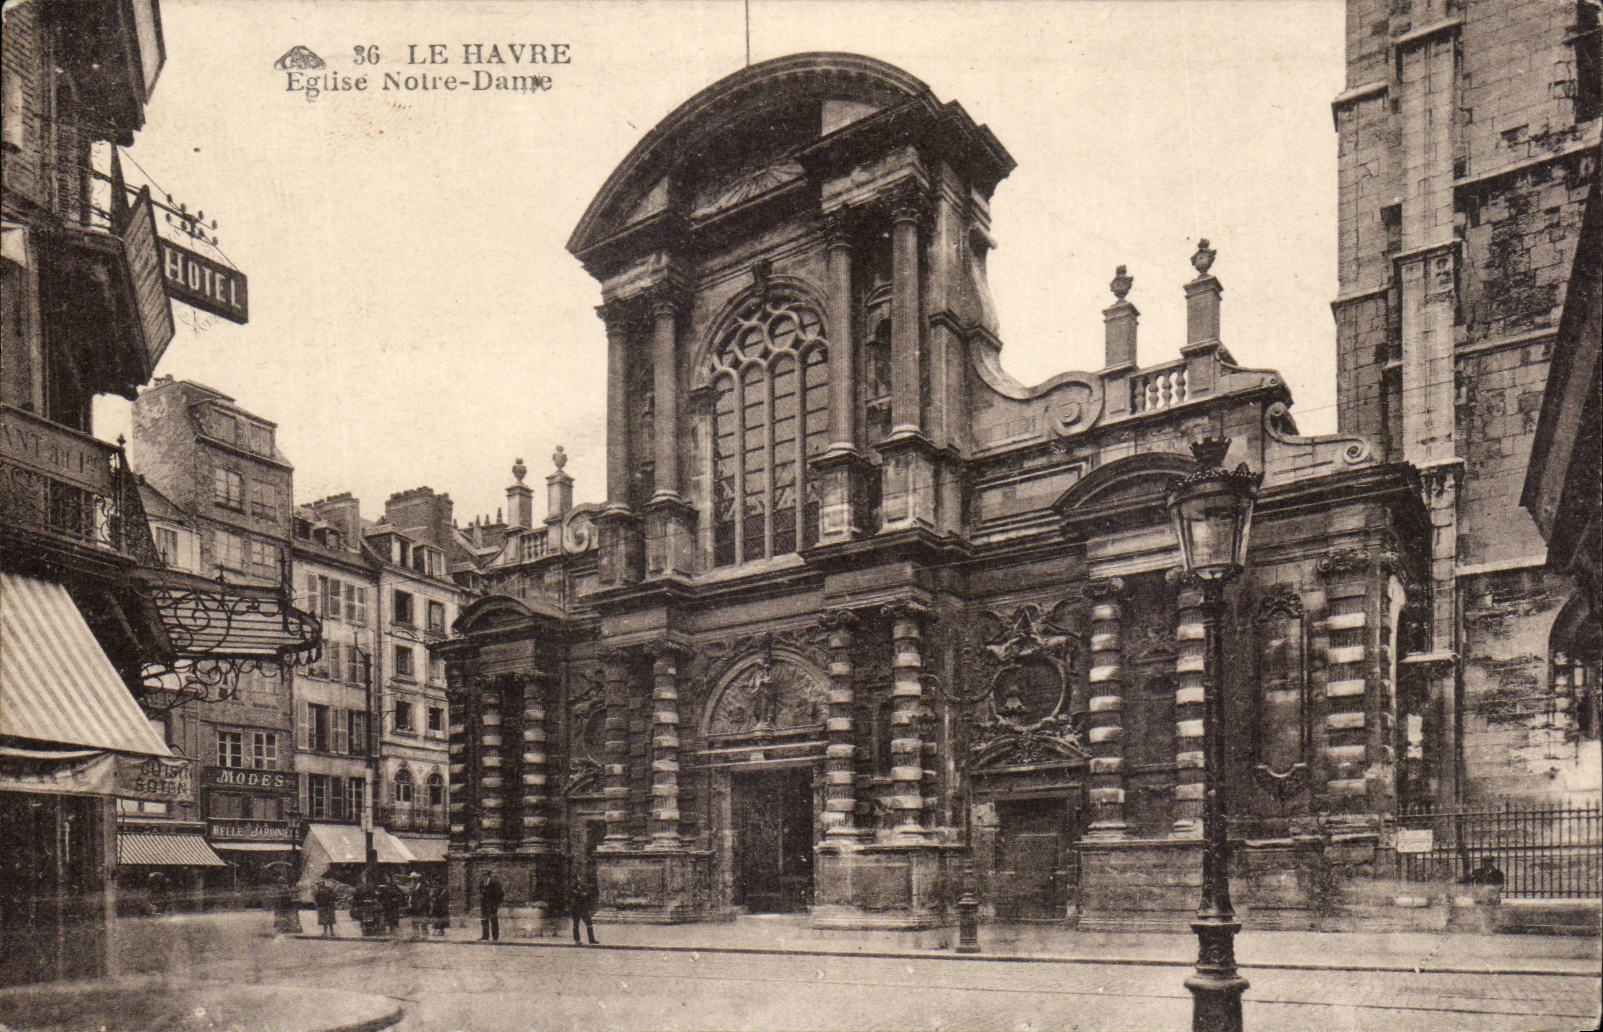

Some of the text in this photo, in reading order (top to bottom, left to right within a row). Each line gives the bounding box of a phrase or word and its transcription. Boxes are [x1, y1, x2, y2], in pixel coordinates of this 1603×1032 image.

[164, 246, 242, 309] HOTEL
[216, 770, 284, 787] MODES
[211, 825, 244, 837] BELLE
